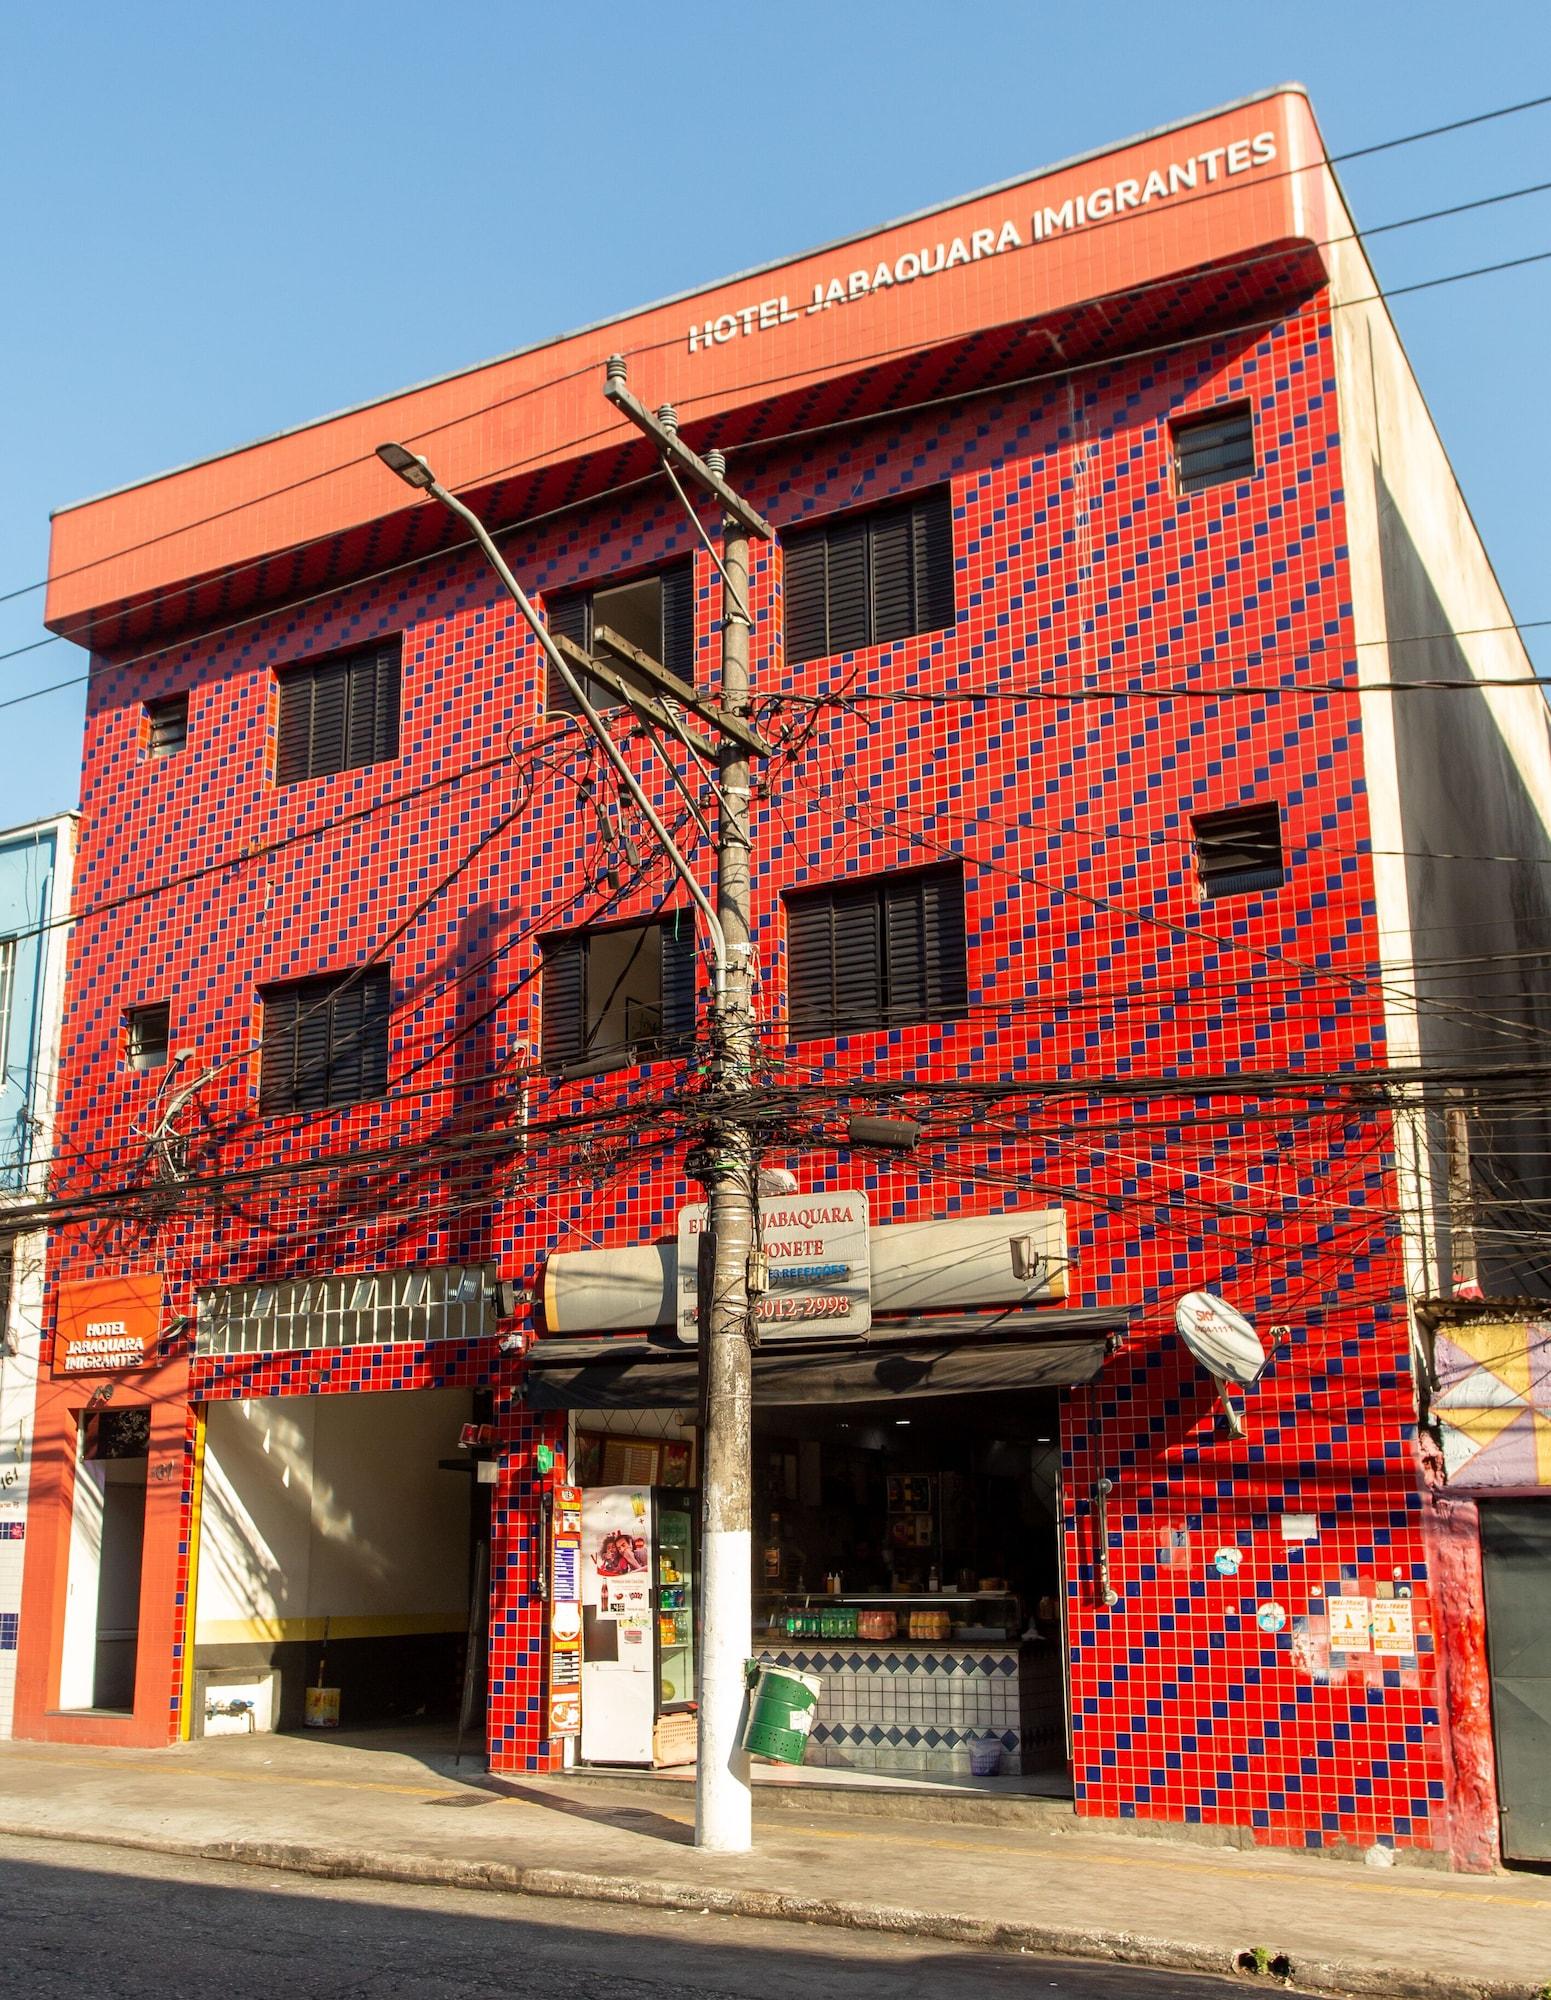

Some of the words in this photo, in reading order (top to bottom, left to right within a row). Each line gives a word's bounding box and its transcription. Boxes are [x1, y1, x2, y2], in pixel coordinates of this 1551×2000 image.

[688, 295, 799, 352] HOTEL
[806, 220, 1022, 315] JABAQUARA
[1032, 131, 1277, 241] IMIGRANTES
[1195, 1310, 1216, 1322] SKY
[86, 1321, 128, 1336] HOTEL
[66, 1337, 144, 1355] JABAQUARA
[65, 1352, 144, 1370] IMIGRANTES
[0, 1466, 19, 1490] 161
